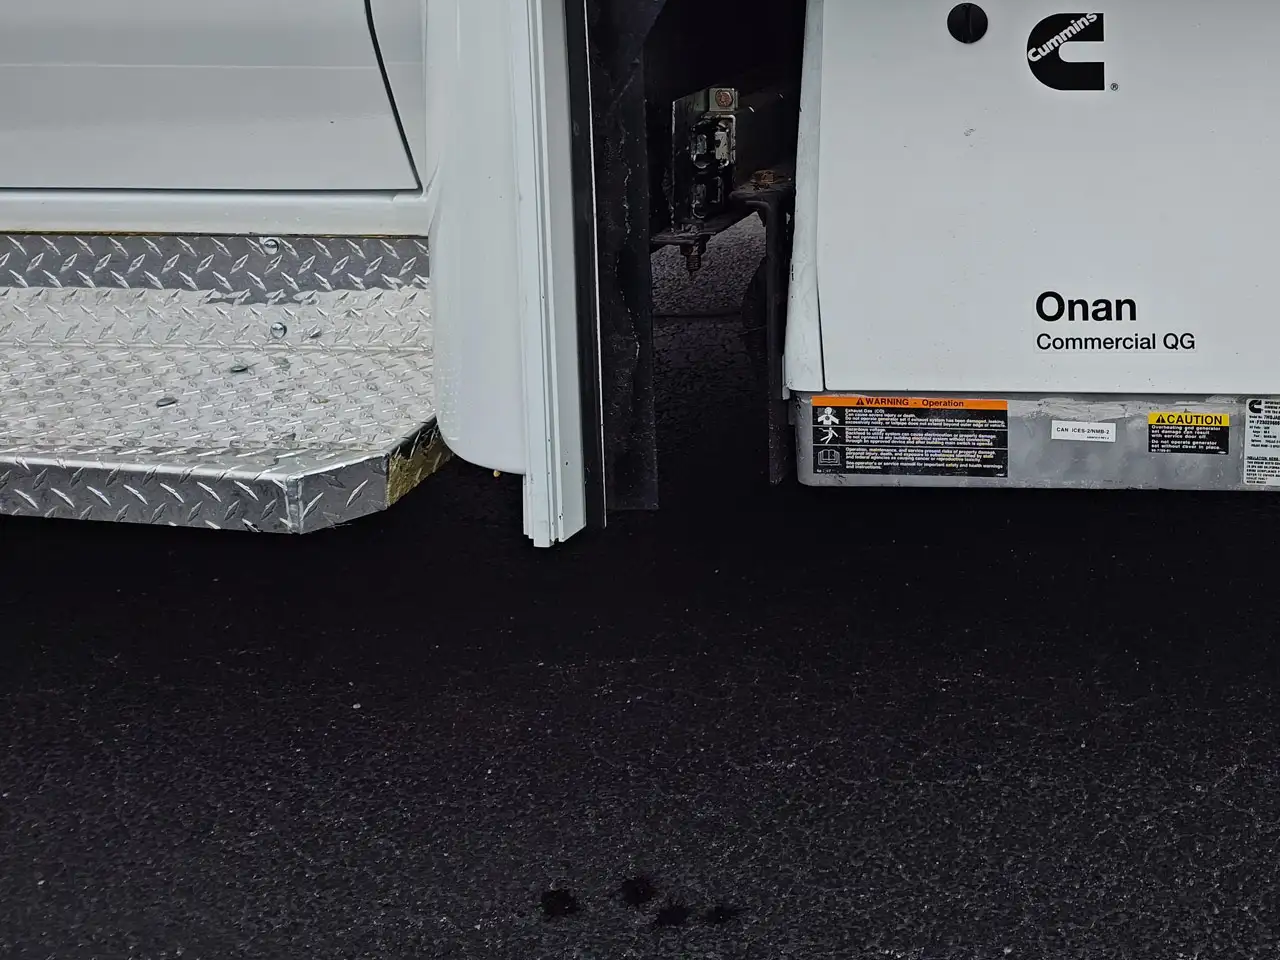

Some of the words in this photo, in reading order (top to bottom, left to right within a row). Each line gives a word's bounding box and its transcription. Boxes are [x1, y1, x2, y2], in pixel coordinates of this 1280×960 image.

[1028, 12, 1098, 62] Cummins
[1036, 291, 1136, 322] Onan
[1036, 333, 1156, 350] Commercial
[1163, 332, 1195, 350] QG
[922, 399, 964, 407] Operation
[1167, 414, 1222, 424] CAUTION
